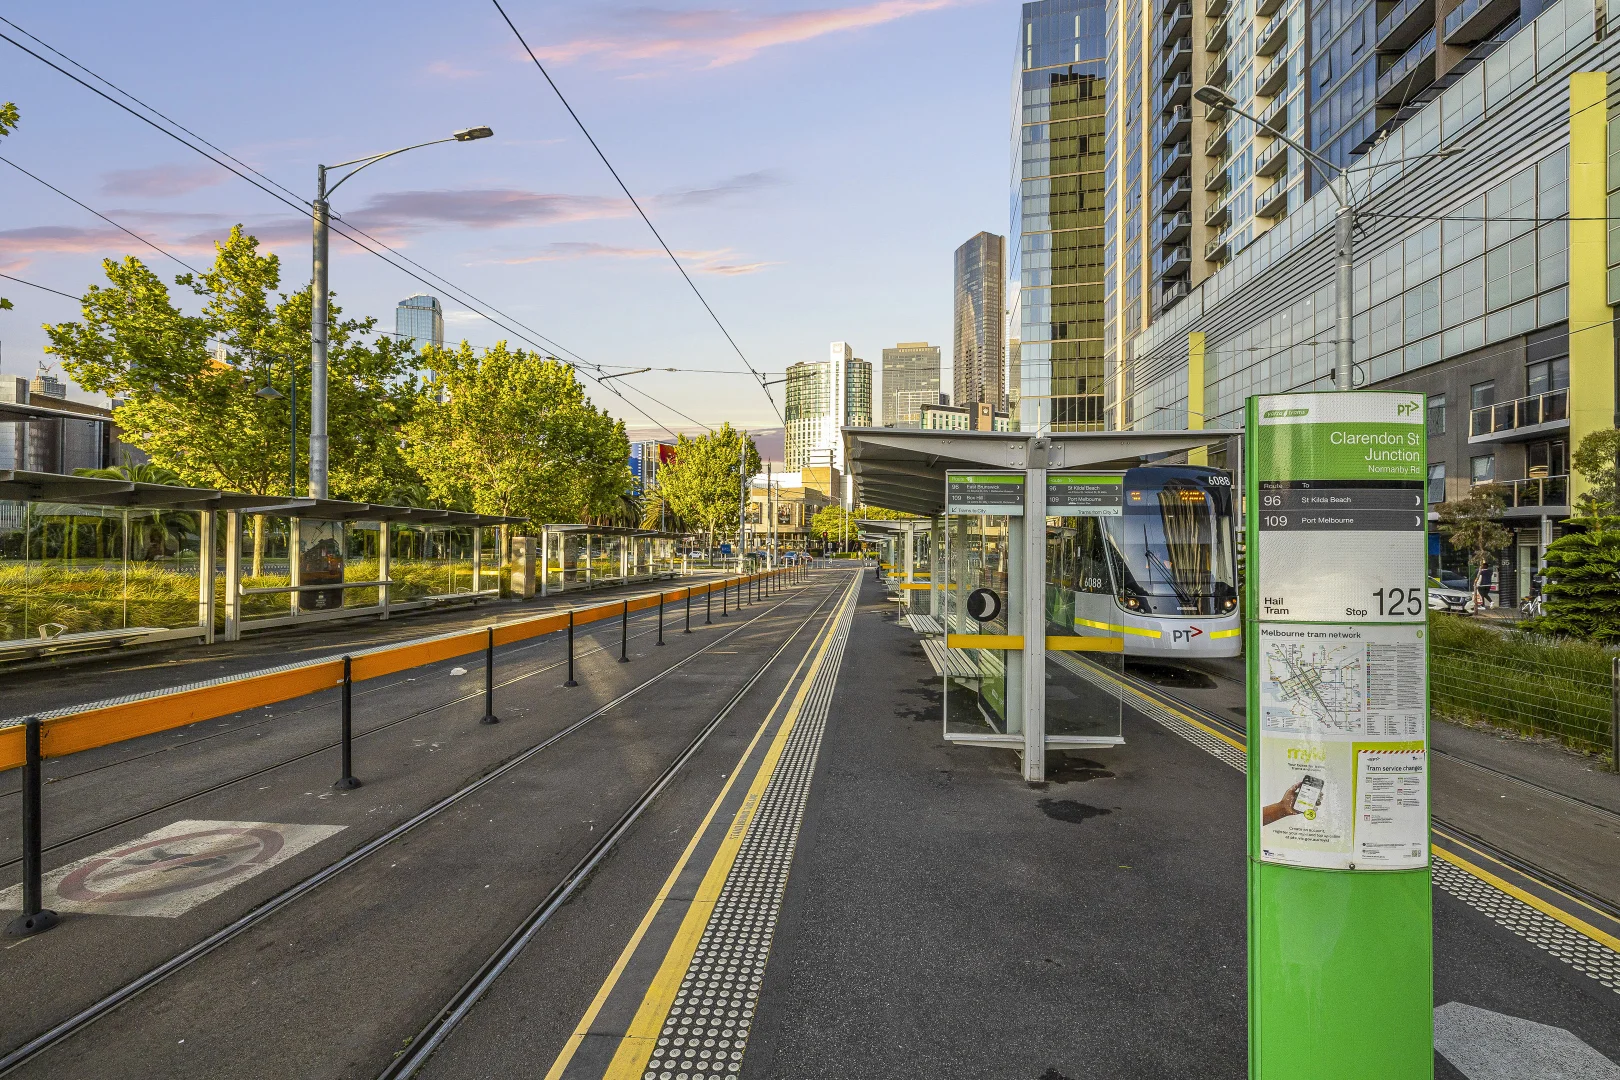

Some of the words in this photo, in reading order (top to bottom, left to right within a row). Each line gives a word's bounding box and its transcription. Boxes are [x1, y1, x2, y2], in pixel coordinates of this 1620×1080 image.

[1330, 431, 1404, 445] Clarendon
[1407, 432, 1420, 445] St
[1364, 447, 1420, 462] Junction
[1368, 465, 1409, 474] Normanby
[1410, 465, 1420, 474] Rd
[1208, 475, 1231, 486] 6088
[1263, 495, 1281, 506] 96
[1263, 515, 1288, 527] 109
[1084, 578, 1102, 588] 6088
[1264, 596, 1284, 605] Hail
[1372, 587, 1422, 616] 125
[1264, 606, 1290, 615] Tram
[1345, 607, 1368, 617] Stop
[1261, 629, 1305, 638] Melbourne
[1307, 631, 1327, 639] tram
[1328, 631, 1361, 639] network
[1366, 764, 1382, 772] Tram
[1402, 764, 1423, 773] changes
